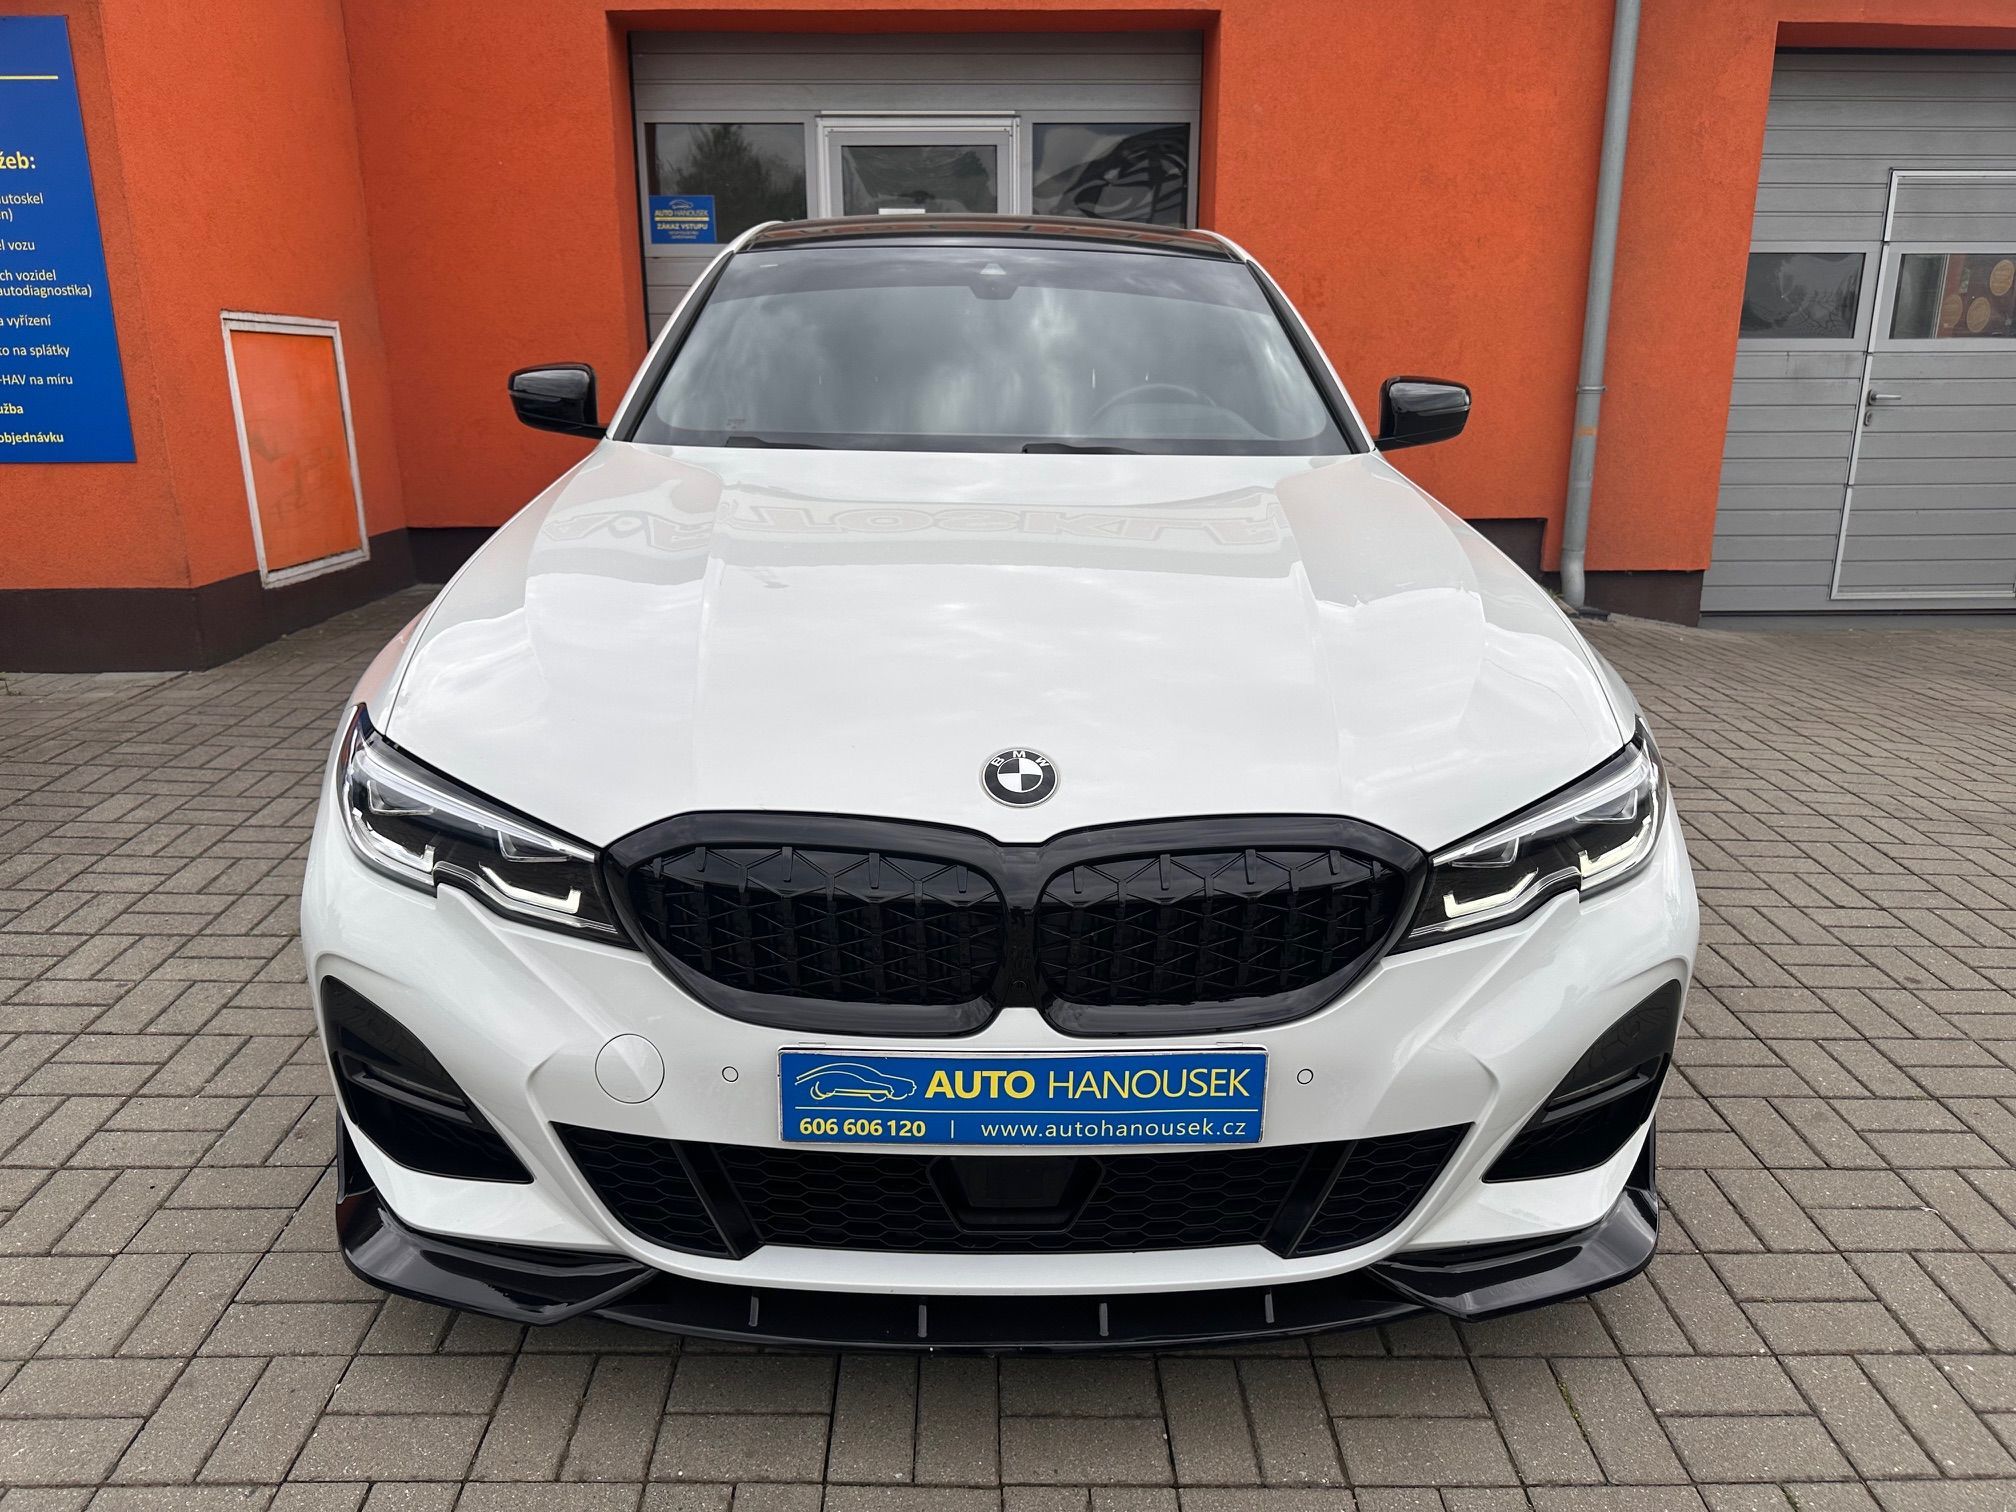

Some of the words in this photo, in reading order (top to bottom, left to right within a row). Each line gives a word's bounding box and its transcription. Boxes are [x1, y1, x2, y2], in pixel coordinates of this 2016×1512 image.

[0, 192, 44, 205] utoskel
[0, 208, 13, 222] n)
[8, 241, 35, 251] vozu
[16, 269, 57, 281] vozidel
[6, 314, 52, 329] vyřízení
[13, 347, 27, 356] na
[29, 344, 70, 358] splátky
[29, 376, 44, 385] na
[46, 373, 73, 385] míru
[991, 750, 1050, 767] BMW
[924, 1070, 1036, 1099] AUTO
[1048, 1068, 1251, 1099] HANOUSEK
[799, 1117, 839, 1136] 606
[843, 1119, 883, 1137] 606
[887, 1120, 926, 1137] 120
[981, 1117, 1246, 1138] www.autohanousek.cz
